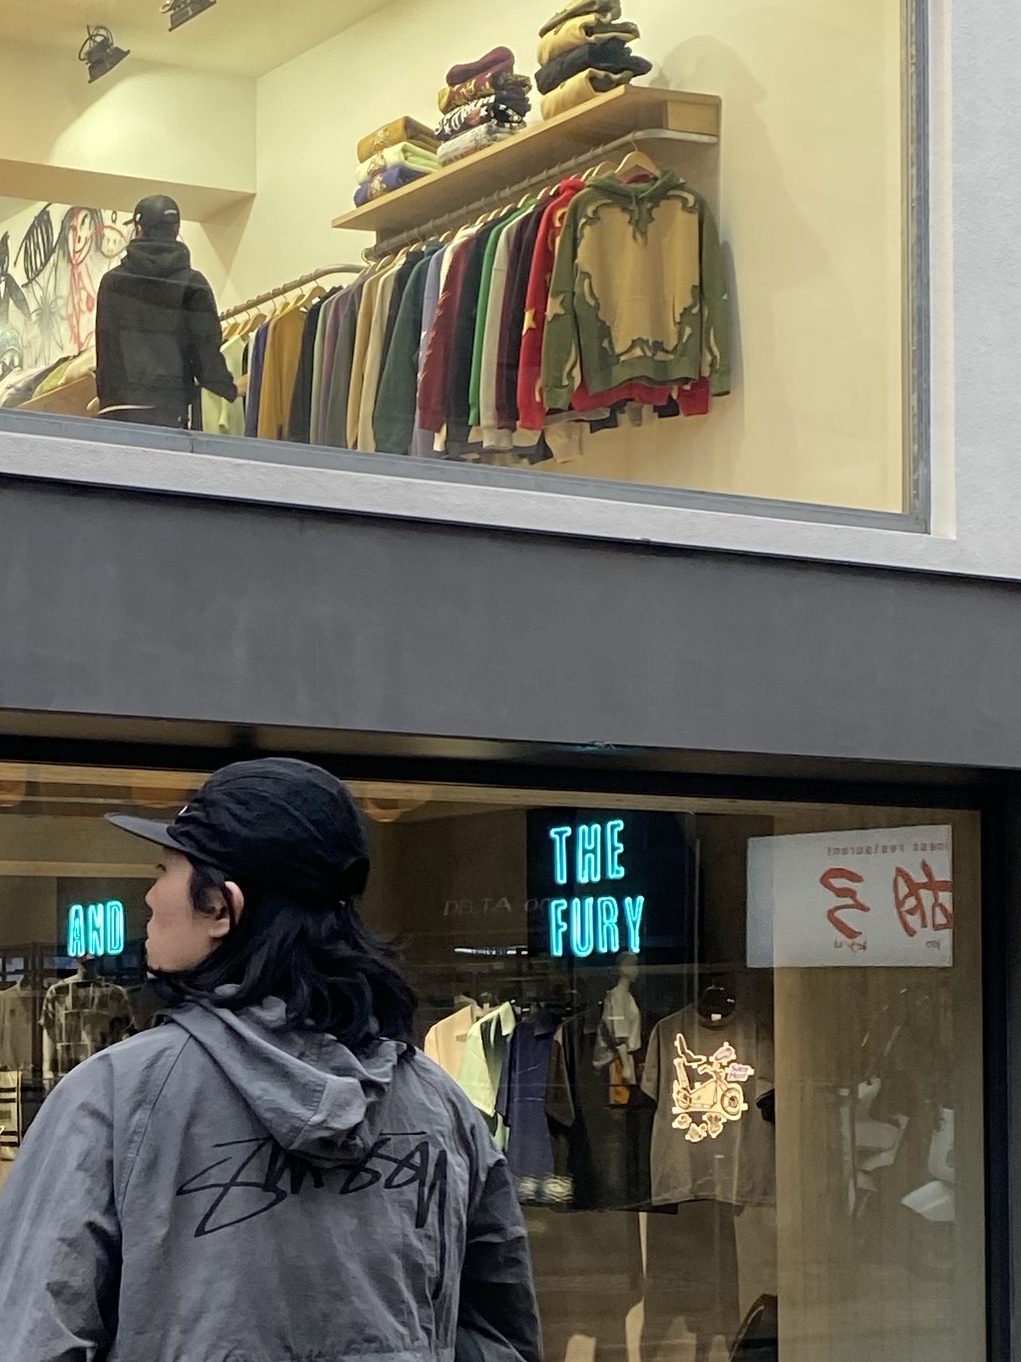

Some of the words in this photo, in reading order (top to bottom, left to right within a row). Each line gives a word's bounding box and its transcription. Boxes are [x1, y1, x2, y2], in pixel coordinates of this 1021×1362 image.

[549, 819, 626, 885] THE
[67, 900, 125, 957] AND
[549, 895, 645, 958] FURY
